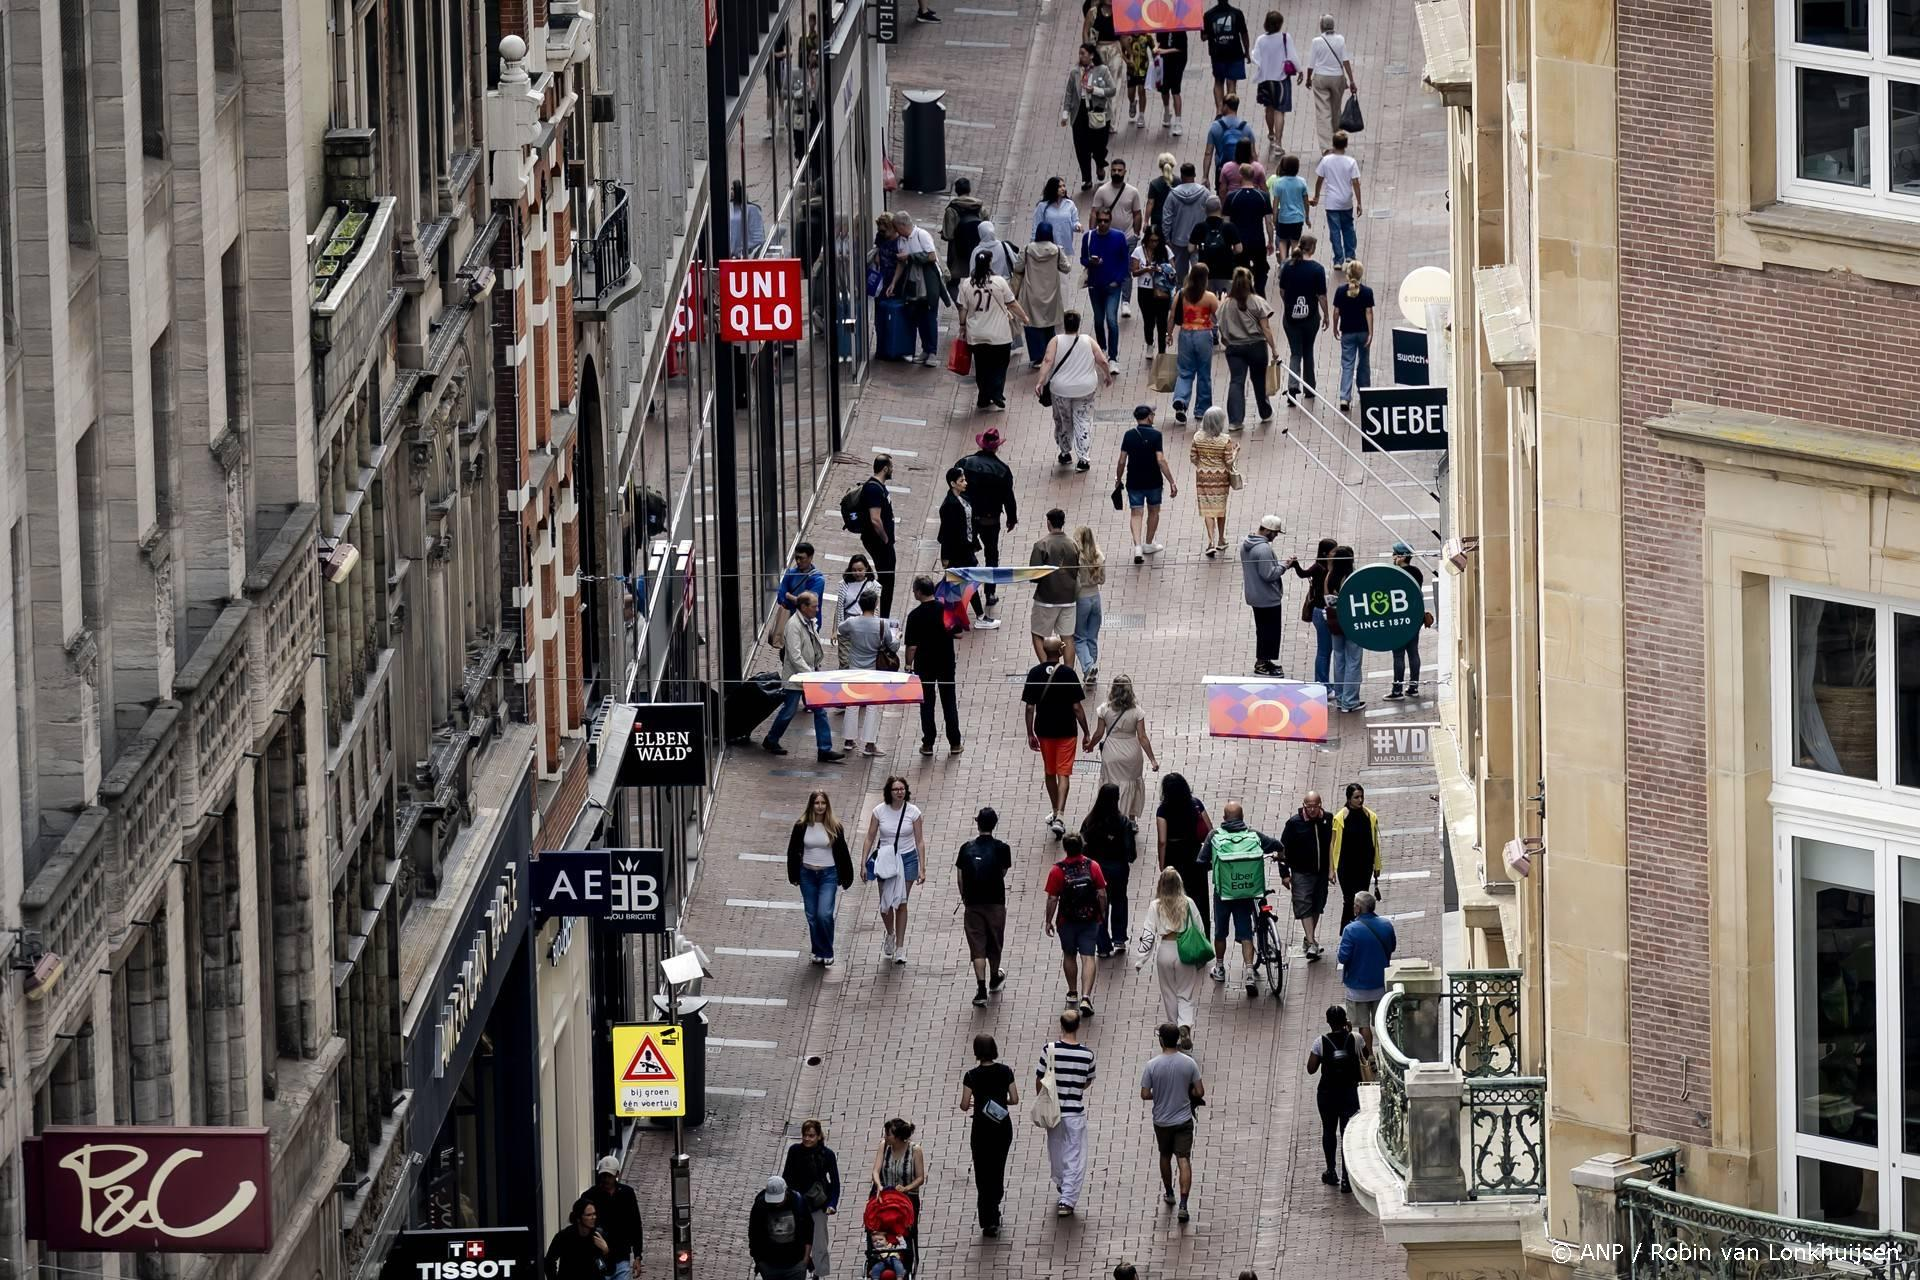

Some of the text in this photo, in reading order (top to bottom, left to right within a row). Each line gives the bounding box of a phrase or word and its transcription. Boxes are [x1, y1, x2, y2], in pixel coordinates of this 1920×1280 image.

[729, 271, 786, 298] UNI
[974, 289, 992, 312] 27
[730, 303, 792, 336] QLO
[1349, 589, 1409, 617] H&B
[1353, 617, 1411, 630] SINCE 1870
[635, 732, 690, 746] ELBEN
[548, 870, 603, 900] AE
[1231, 873, 1254, 881] Uber
[1232, 882, 1254, 890] Eats
[626, 913, 656, 921] BRIGITTE
[631, 1089, 669, 1098] bij groen
[624, 1100, 678, 1109] één voertuig
[59, 1144, 257, 1237] P&C
[416, 1260, 516, 1280] TISSOT
